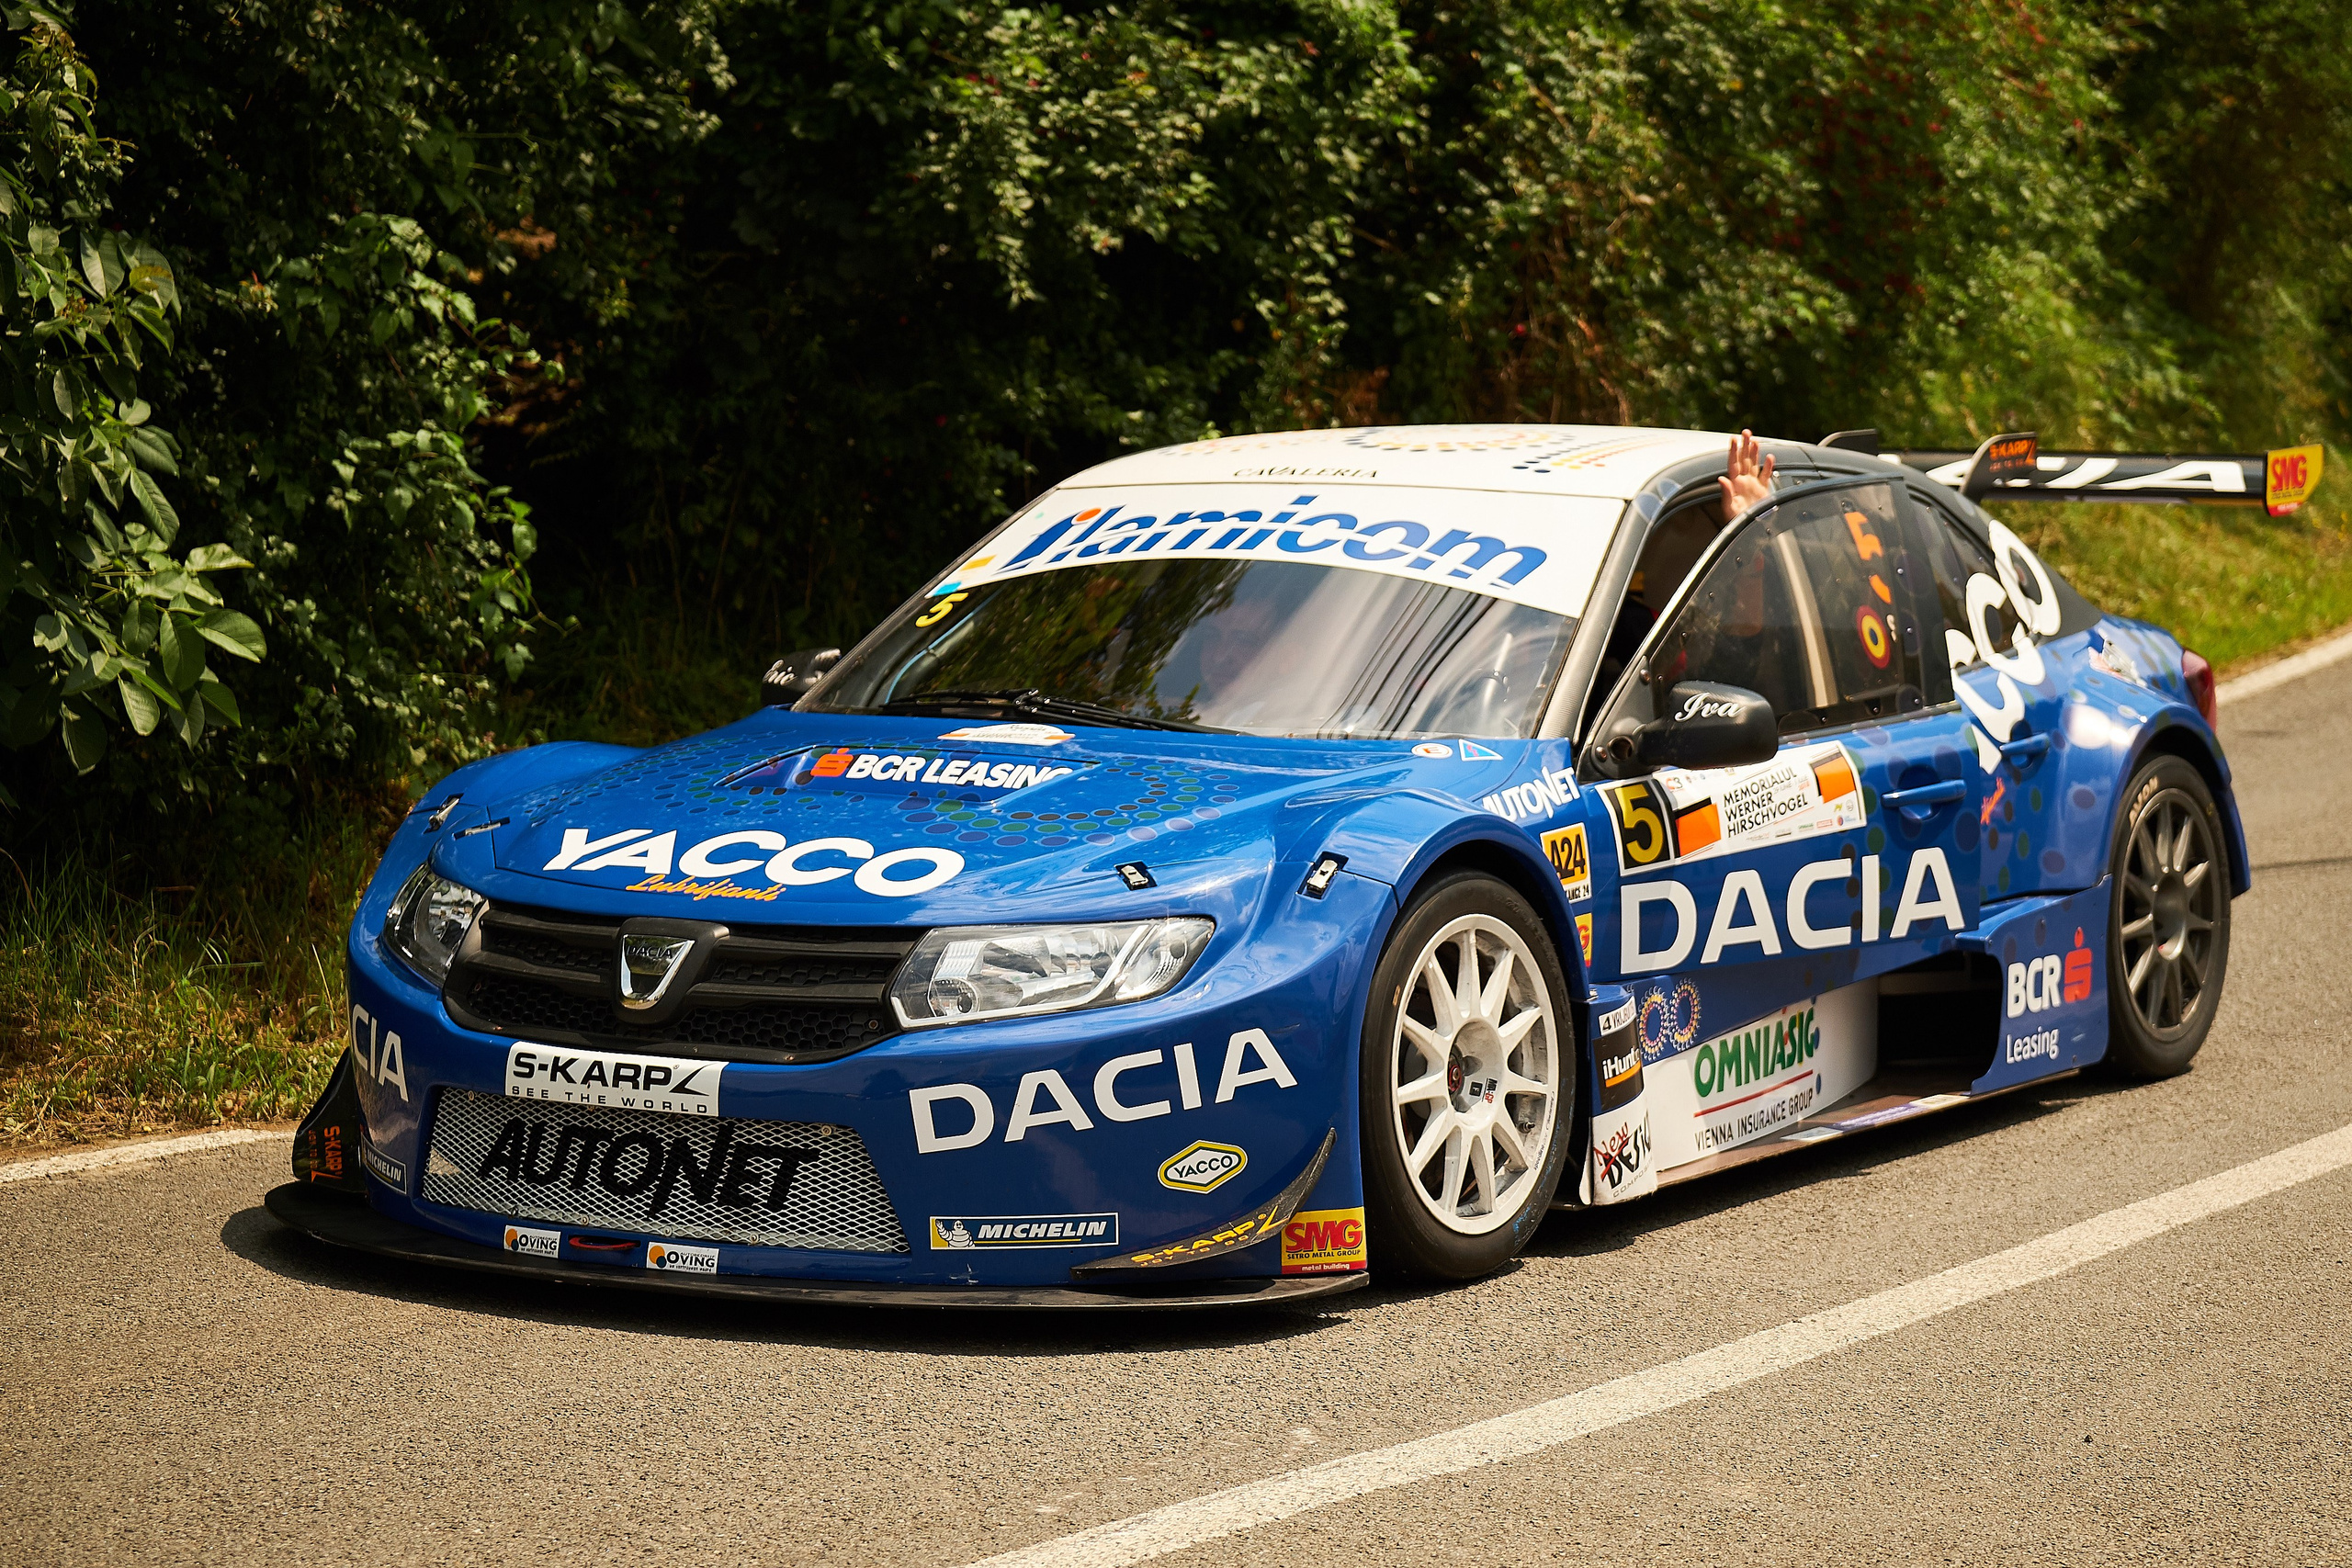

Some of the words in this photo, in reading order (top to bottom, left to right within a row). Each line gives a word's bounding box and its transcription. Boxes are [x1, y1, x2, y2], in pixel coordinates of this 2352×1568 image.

[1233, 466, 1377, 479] CAVALERIA
[2271, 454, 2307, 492] SMG
[916, 592, 969, 627] 5
[1674, 693, 1747, 723] Iva
[845, 754, 926, 782] BCR
[1723, 766, 1797, 807] MEMORIALUL
[1482, 766, 1580, 821] AUTONET
[1724, 791, 1776, 821] WERNER
[1614, 784, 1664, 863] 5
[1727, 793, 1808, 838] HIRSCHVOGEL
[543, 829, 966, 897] YACCO
[1620, 847, 1964, 975] DACIA
[626, 945, 673, 958] DACIA
[2007, 953, 2062, 1019] BCR
[1694, 1007, 1815, 1098] OMNIASIG
[2006, 1025, 2060, 1064] Leasing
[513, 1052, 673, 1091] S-KARP
[511, 1086, 549, 1099] SEE
[565, 1091, 606, 1105] THE
[621, 1097, 707, 1114] WORLD
[909, 1028, 1298, 1154] DACIA
[1694, 1124, 1734, 1152] VIENNA
[1736, 1101, 1786, 1138] INSURANCE
[1788, 1088, 1814, 1116] GROUP
[478, 1117, 822, 1218] AUTONET
[1172, 1154, 1234, 1179] YACCO
[518, 1234, 558, 1251] OVING
[977, 1220, 1107, 1239] MICHELIN
[1131, 1221, 1256, 1263] S-KARP
[1284, 1219, 1363, 1253] SMG
[666, 1250, 716, 1269] OVING
[1311, 1250, 1335, 1259] METAL
[1336, 1248, 1361, 1258] GROUP
[1323, 1262, 1350, 1270] building
